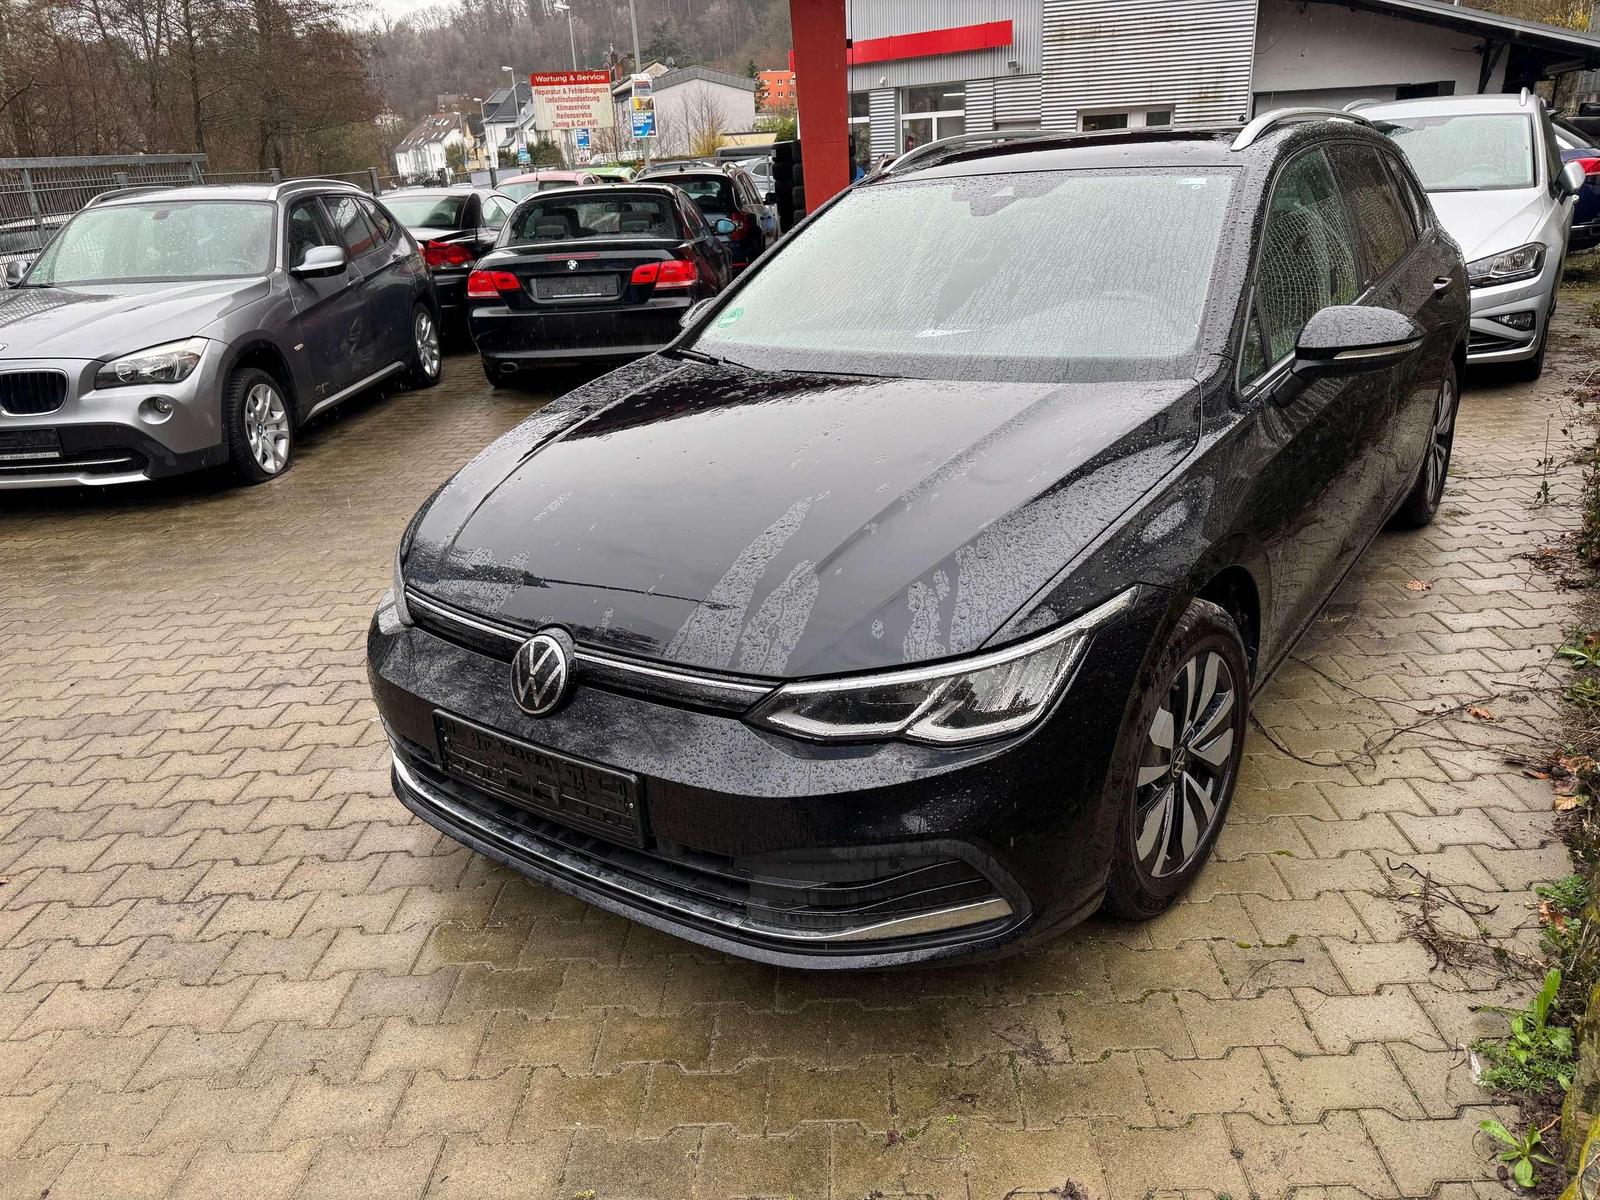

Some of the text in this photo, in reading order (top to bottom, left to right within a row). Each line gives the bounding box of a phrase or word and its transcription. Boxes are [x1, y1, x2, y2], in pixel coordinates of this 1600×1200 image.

[535, 88, 561, 96] Reparatur
[545, 95, 600, 103] Unfallinstandsetzung
[556, 103, 590, 111] Klimaservice
[552, 120, 570, 128] Tuning
[511, 635, 567, 715] VW
